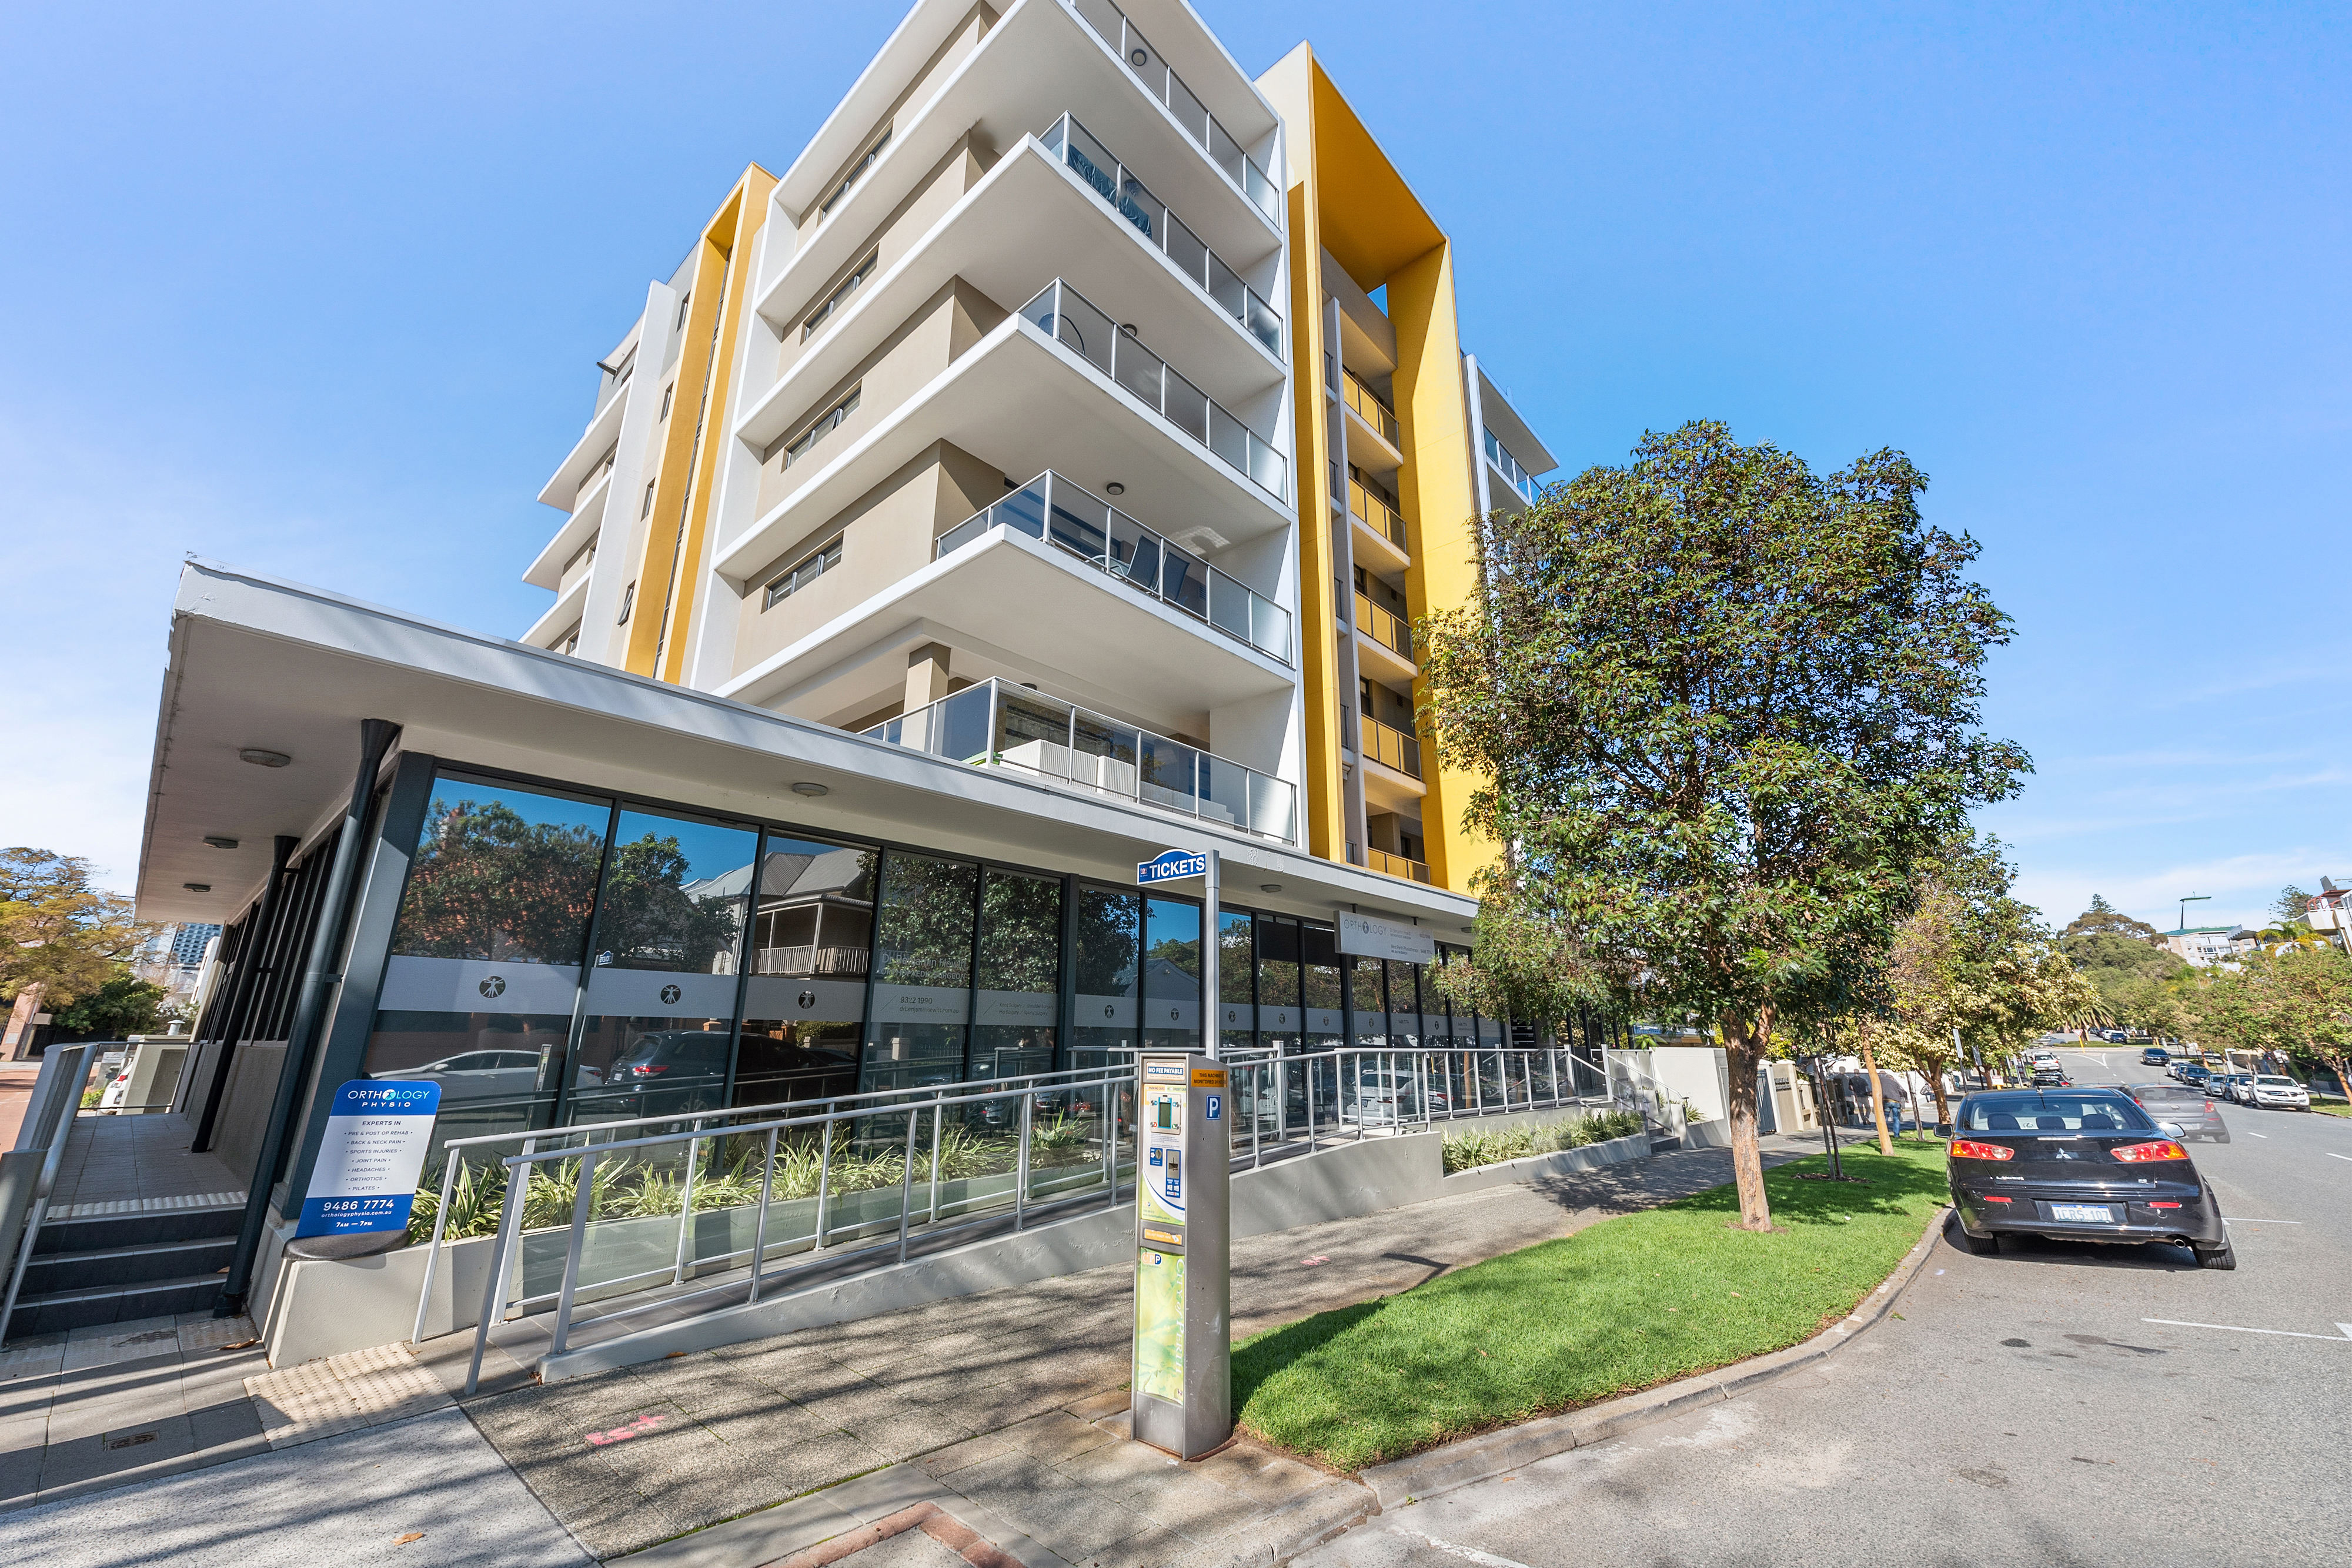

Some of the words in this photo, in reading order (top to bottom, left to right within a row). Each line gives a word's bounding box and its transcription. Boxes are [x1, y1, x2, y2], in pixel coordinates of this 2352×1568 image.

[1149, 857, 1205, 878] TICKETS
[1344, 919, 1387, 935] ORTHOLOGY
[348, 1089, 430, 1101] ORTHOLOGY
[1210, 1098, 1218, 1117] P
[323, 1201, 359, 1211] 9486
[363, 1199, 394, 1209] 7774
[321, 1210, 392, 1218] orthologyphysio.com.au
